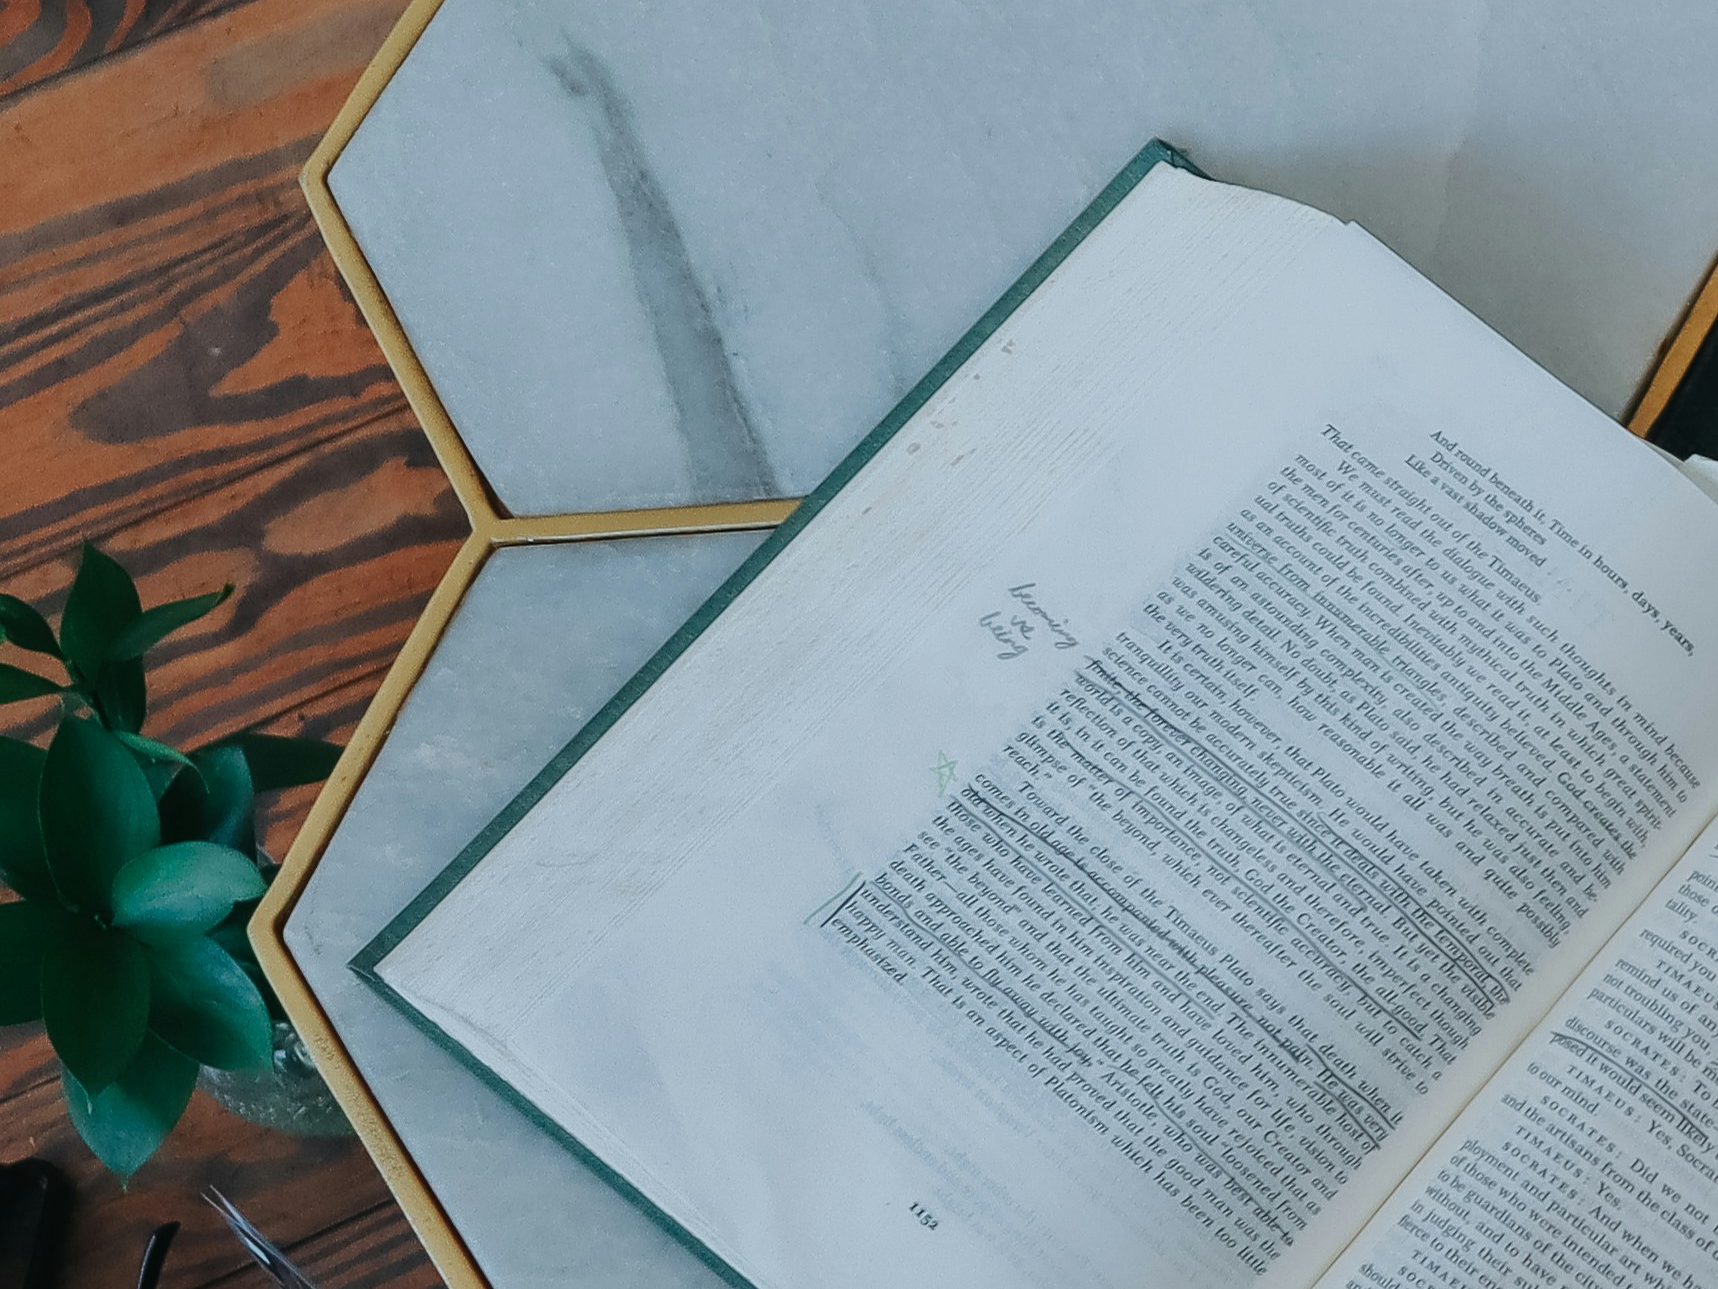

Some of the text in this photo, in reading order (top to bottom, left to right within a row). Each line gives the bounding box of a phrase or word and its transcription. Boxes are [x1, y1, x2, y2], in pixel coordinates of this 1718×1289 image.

[1320, 423, 1541, 606] That came straight out of the Timaeus.
[1404, 453, 1548, 568] Like a vast shadow moved
[1429, 450, 1547, 546] Driven by the spheres
[1429, 430, 1694, 656] And round beneath it, Time in hours, days, years,
[979, 610, 1028, 659] being
[1007, 583, 1080, 649] becoming
[830, 916, 908, 986] emphasized.
[844, 900, 1267, 1276] happy man. That is an aspect of Platonism which has been too little
[909, 1202, 939, 1231] 1152
